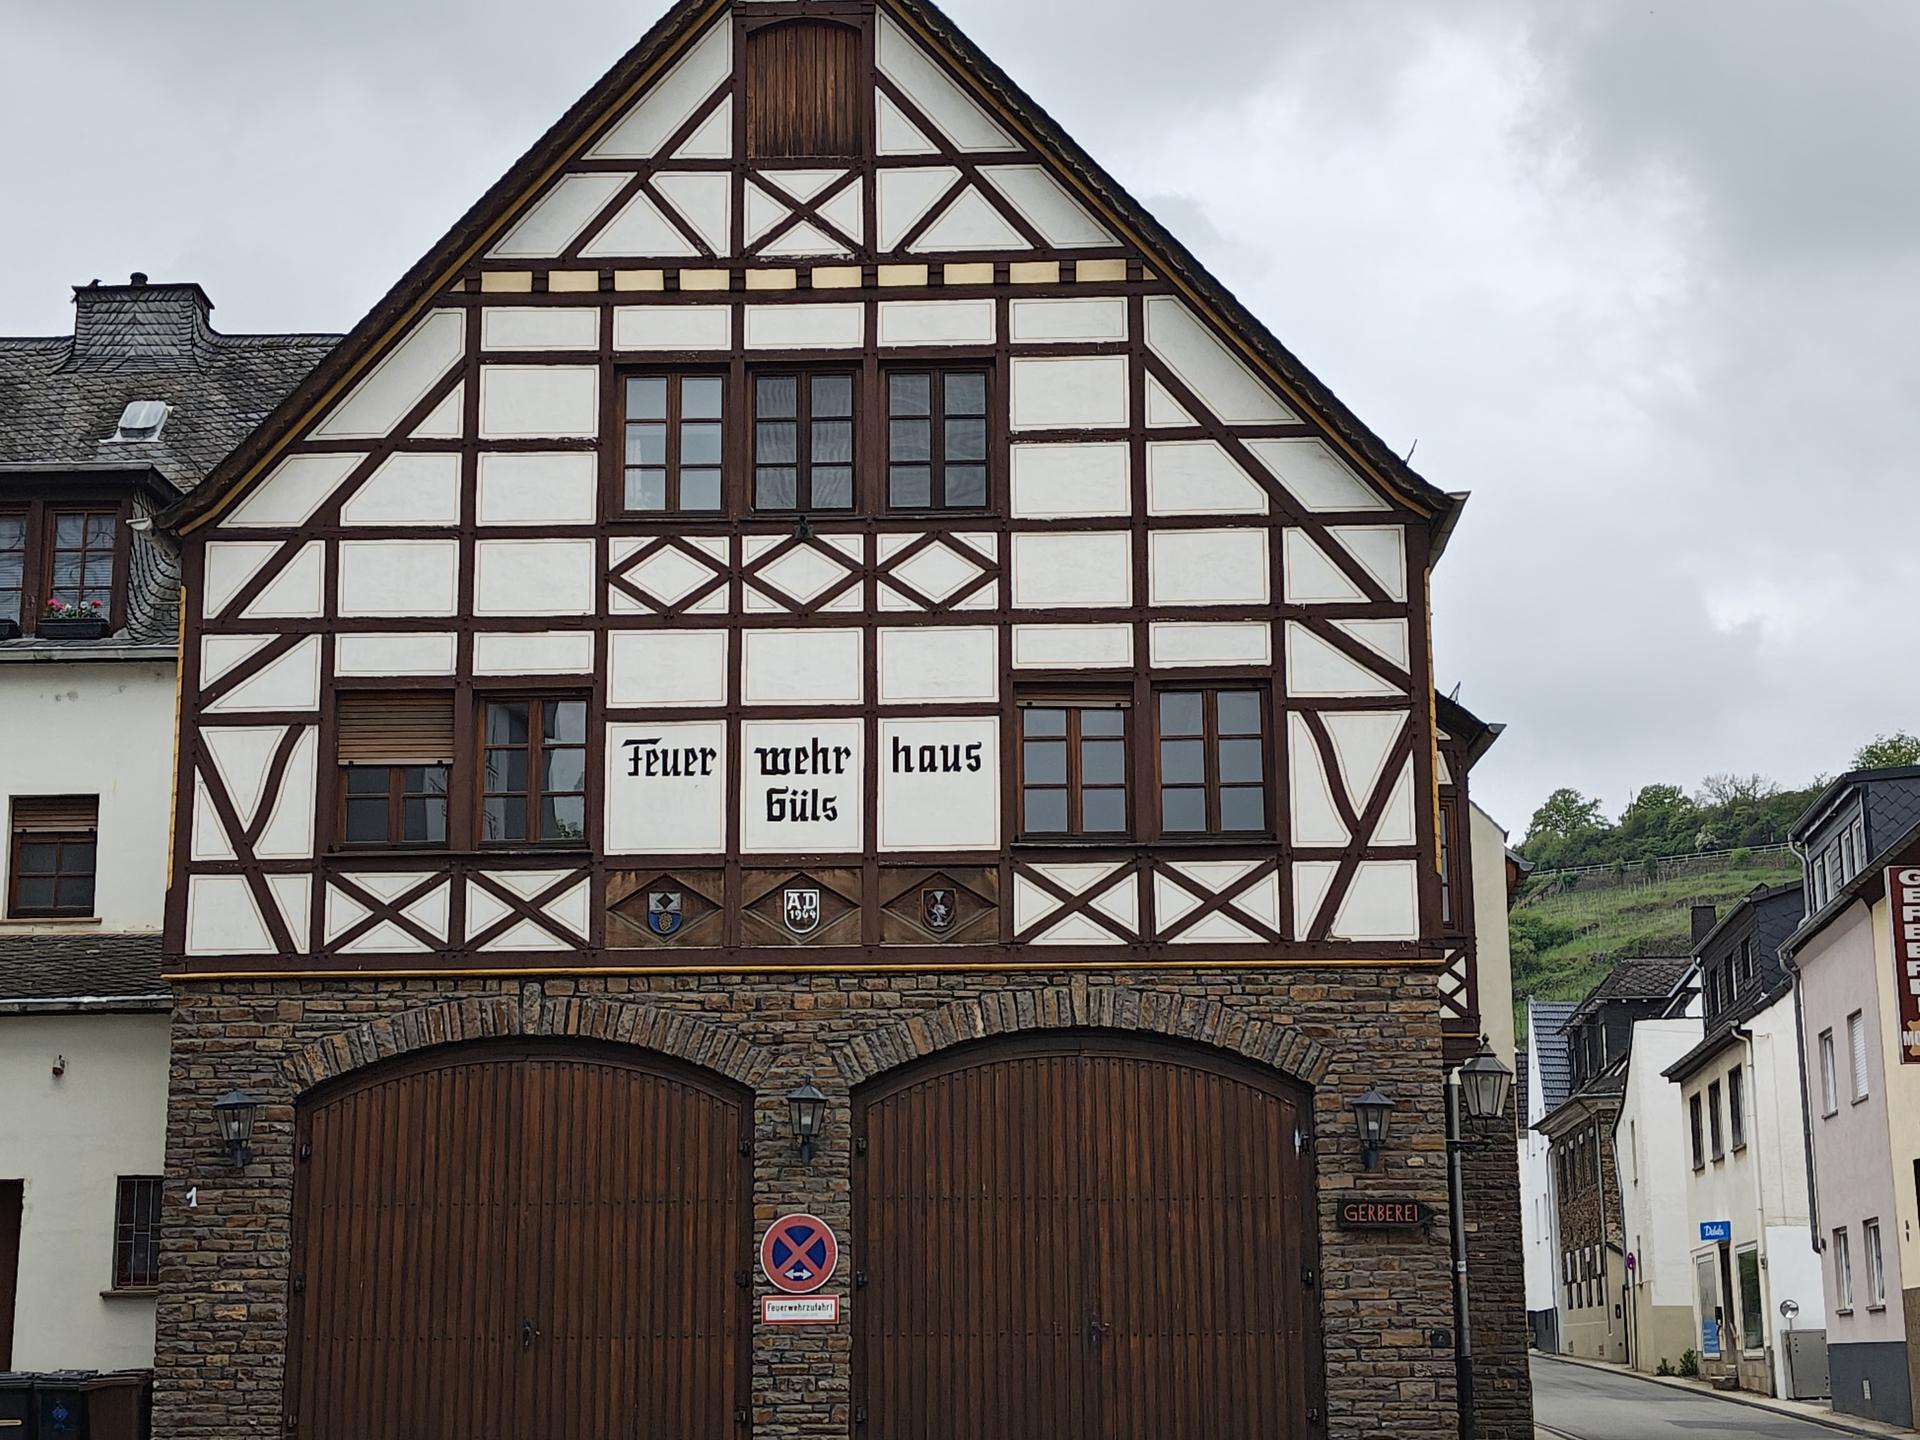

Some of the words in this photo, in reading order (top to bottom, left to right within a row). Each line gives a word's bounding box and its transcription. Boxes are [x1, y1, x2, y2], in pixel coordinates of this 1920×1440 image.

[621, 737, 717, 776] Feuer
[754, 737, 851, 775] wehr
[892, 736, 982, 773] haus
[766, 786, 838, 822] Güls
[186, 1186, 198, 1208] 1
[1343, 1203, 1418, 1222] GERBEREI
[767, 1302, 833, 1312] Feuerwehrzufahrt
